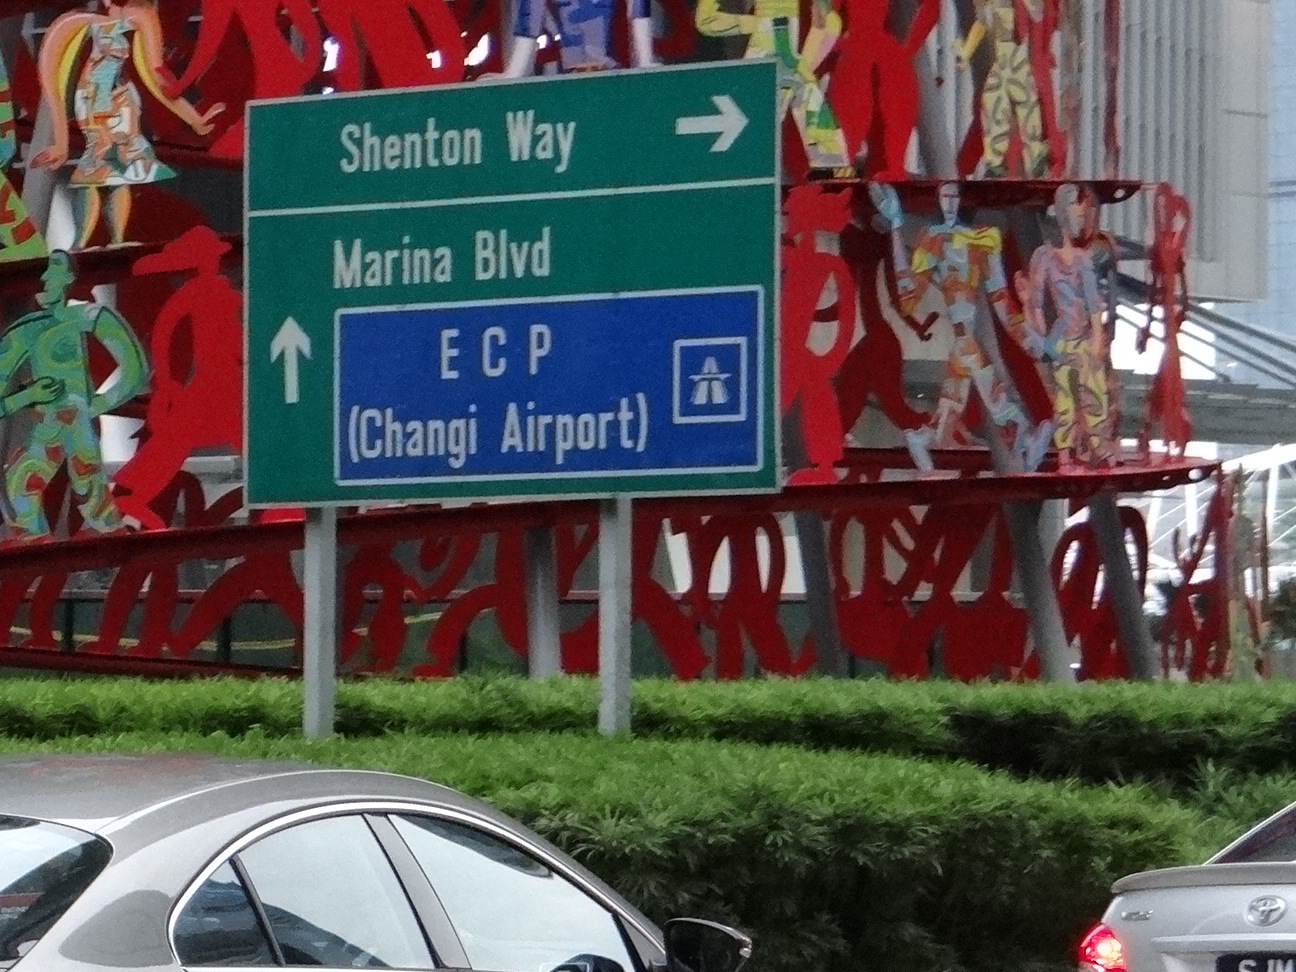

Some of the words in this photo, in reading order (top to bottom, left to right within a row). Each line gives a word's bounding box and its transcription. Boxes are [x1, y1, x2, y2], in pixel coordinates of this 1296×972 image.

[339, 117, 483, 173] Shenton
[505, 110, 576, 173] Way
[333, 235, 452, 289] Marina
[475, 226, 552, 281] Blvd
[349, 404, 478, 468] (Changi
[501, 392, 648, 465] Airport)
